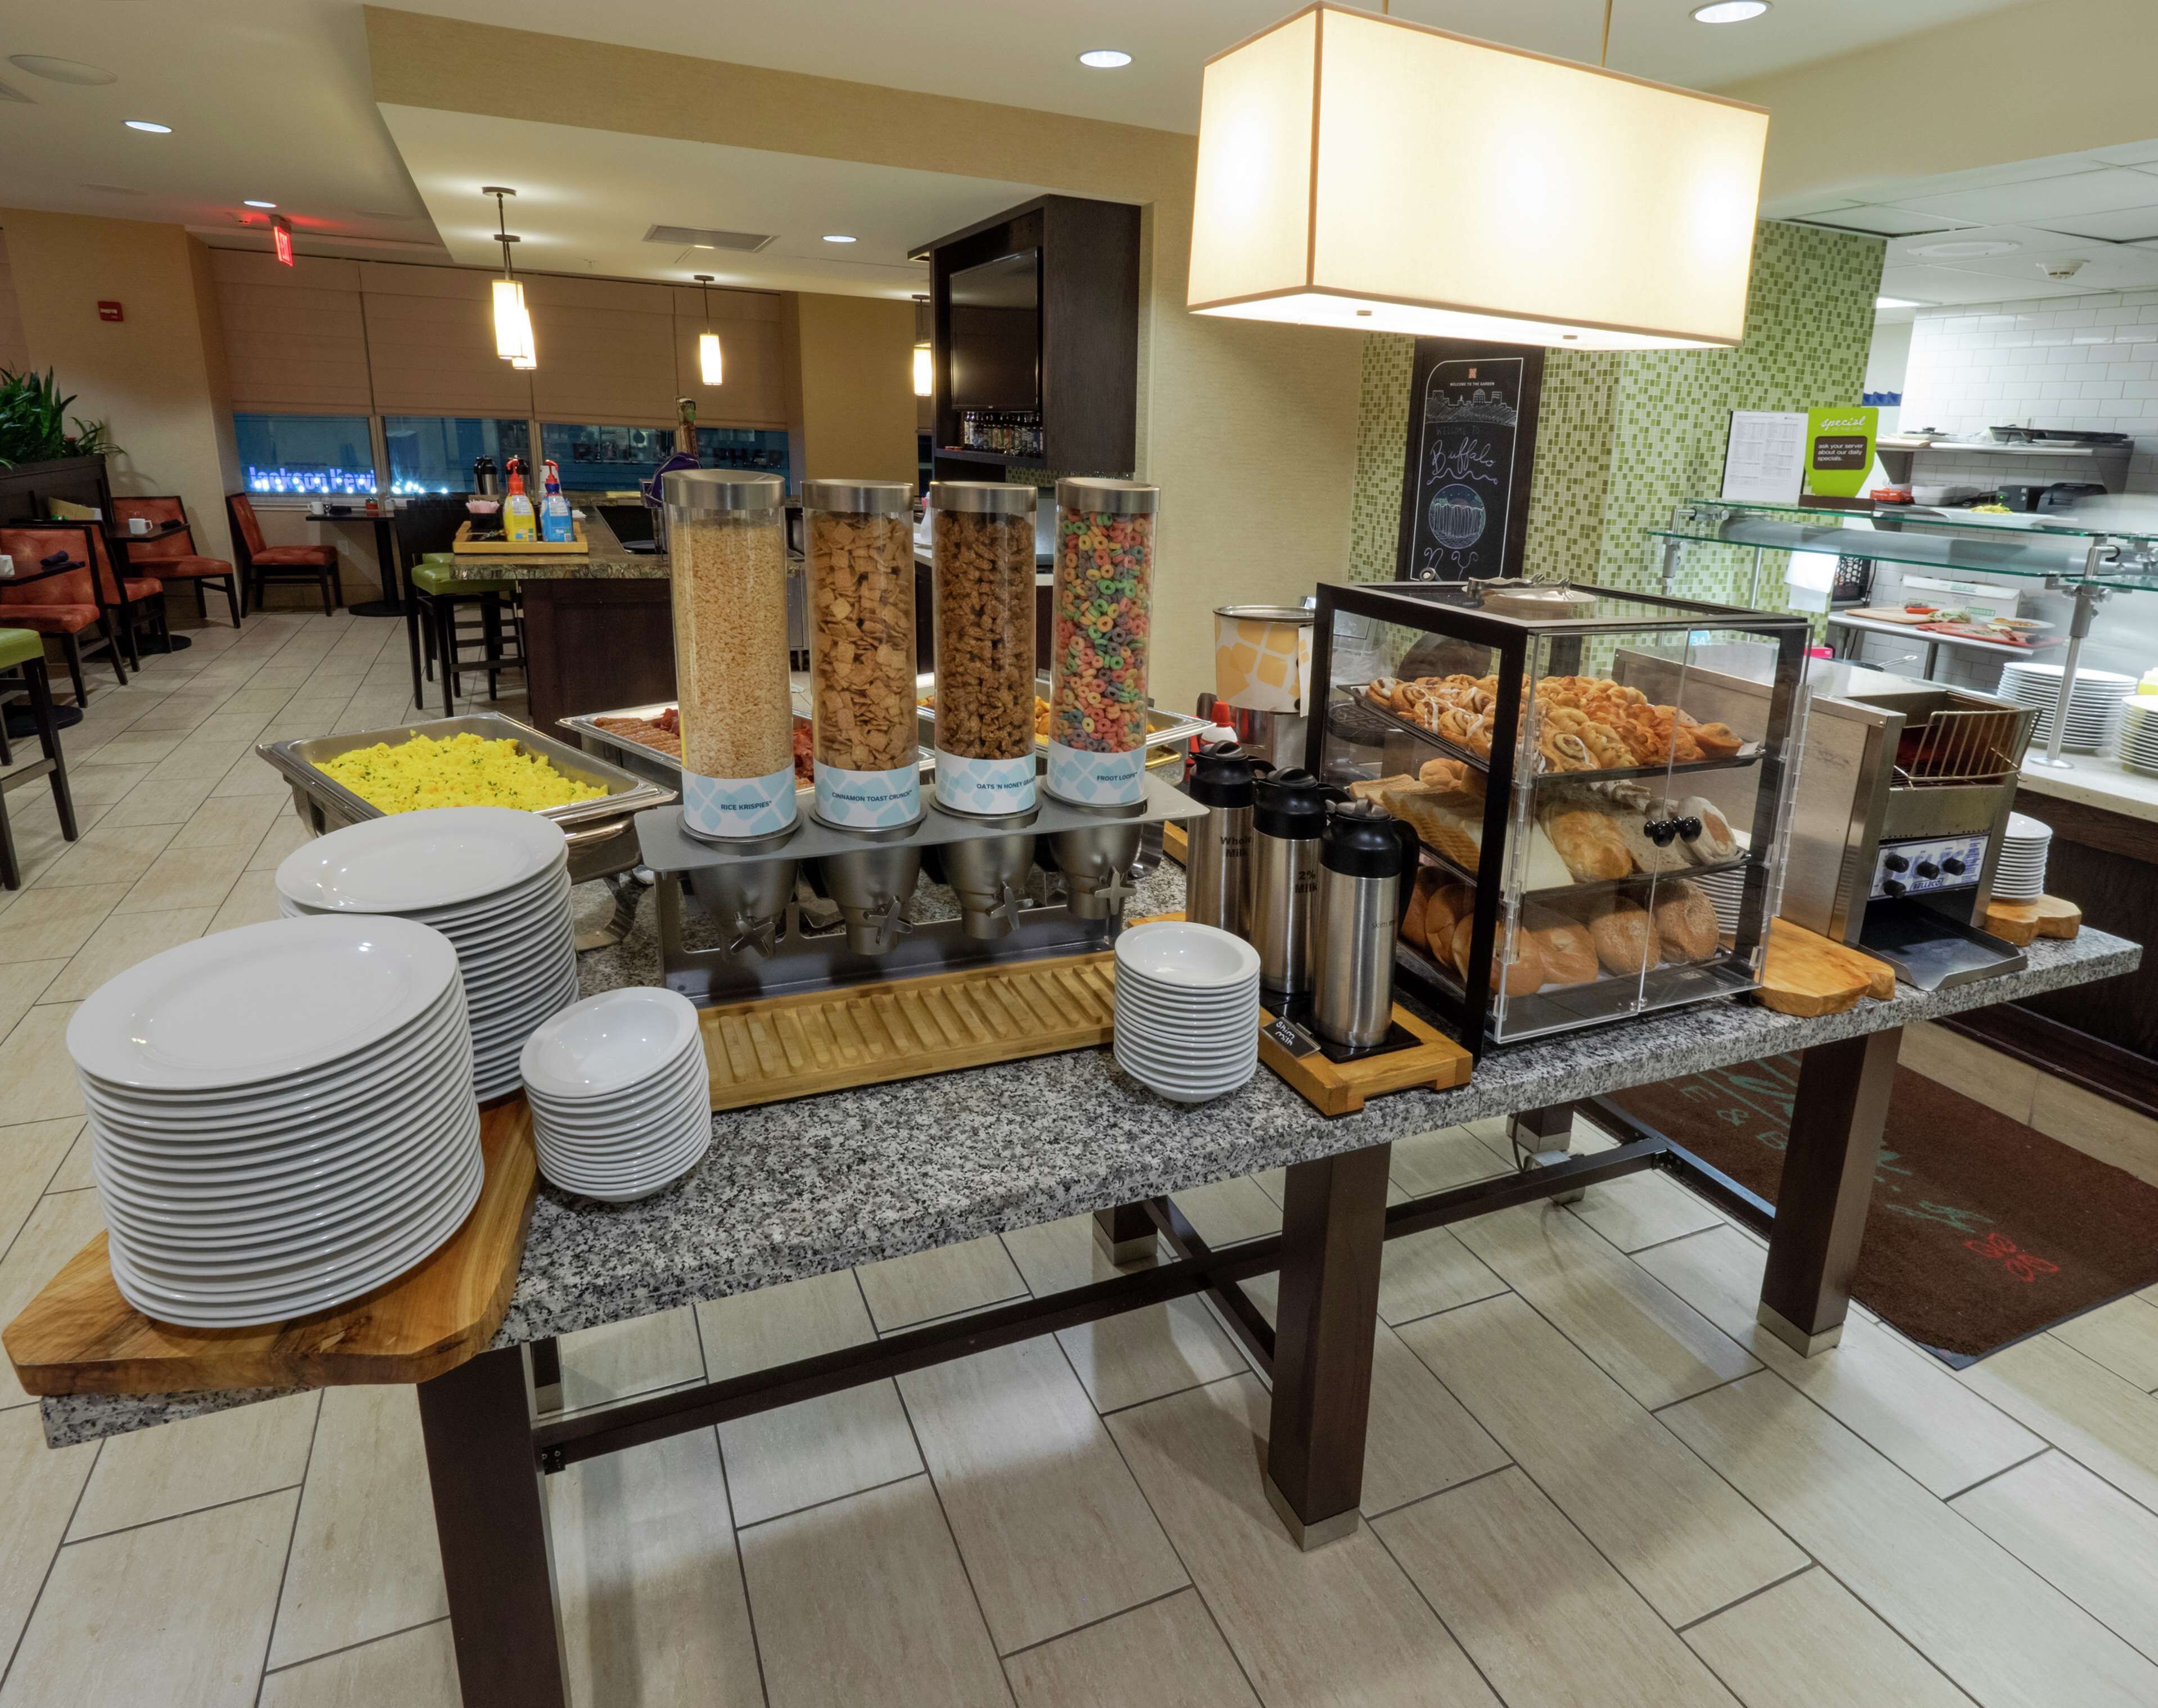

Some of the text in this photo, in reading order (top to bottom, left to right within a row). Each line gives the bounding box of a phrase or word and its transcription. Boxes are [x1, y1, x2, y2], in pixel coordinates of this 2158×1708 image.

[1821, 415, 1866, 431] special
[1430, 437, 1496, 475] Buffalo
[832, 791, 865, 801] CINNAMON
[867, 790, 888, 801] TOAST
[1226, 849, 1247, 857] Milk
[1299, 871, 1316, 880] 2%
[1295, 883, 1318, 893] Milk
